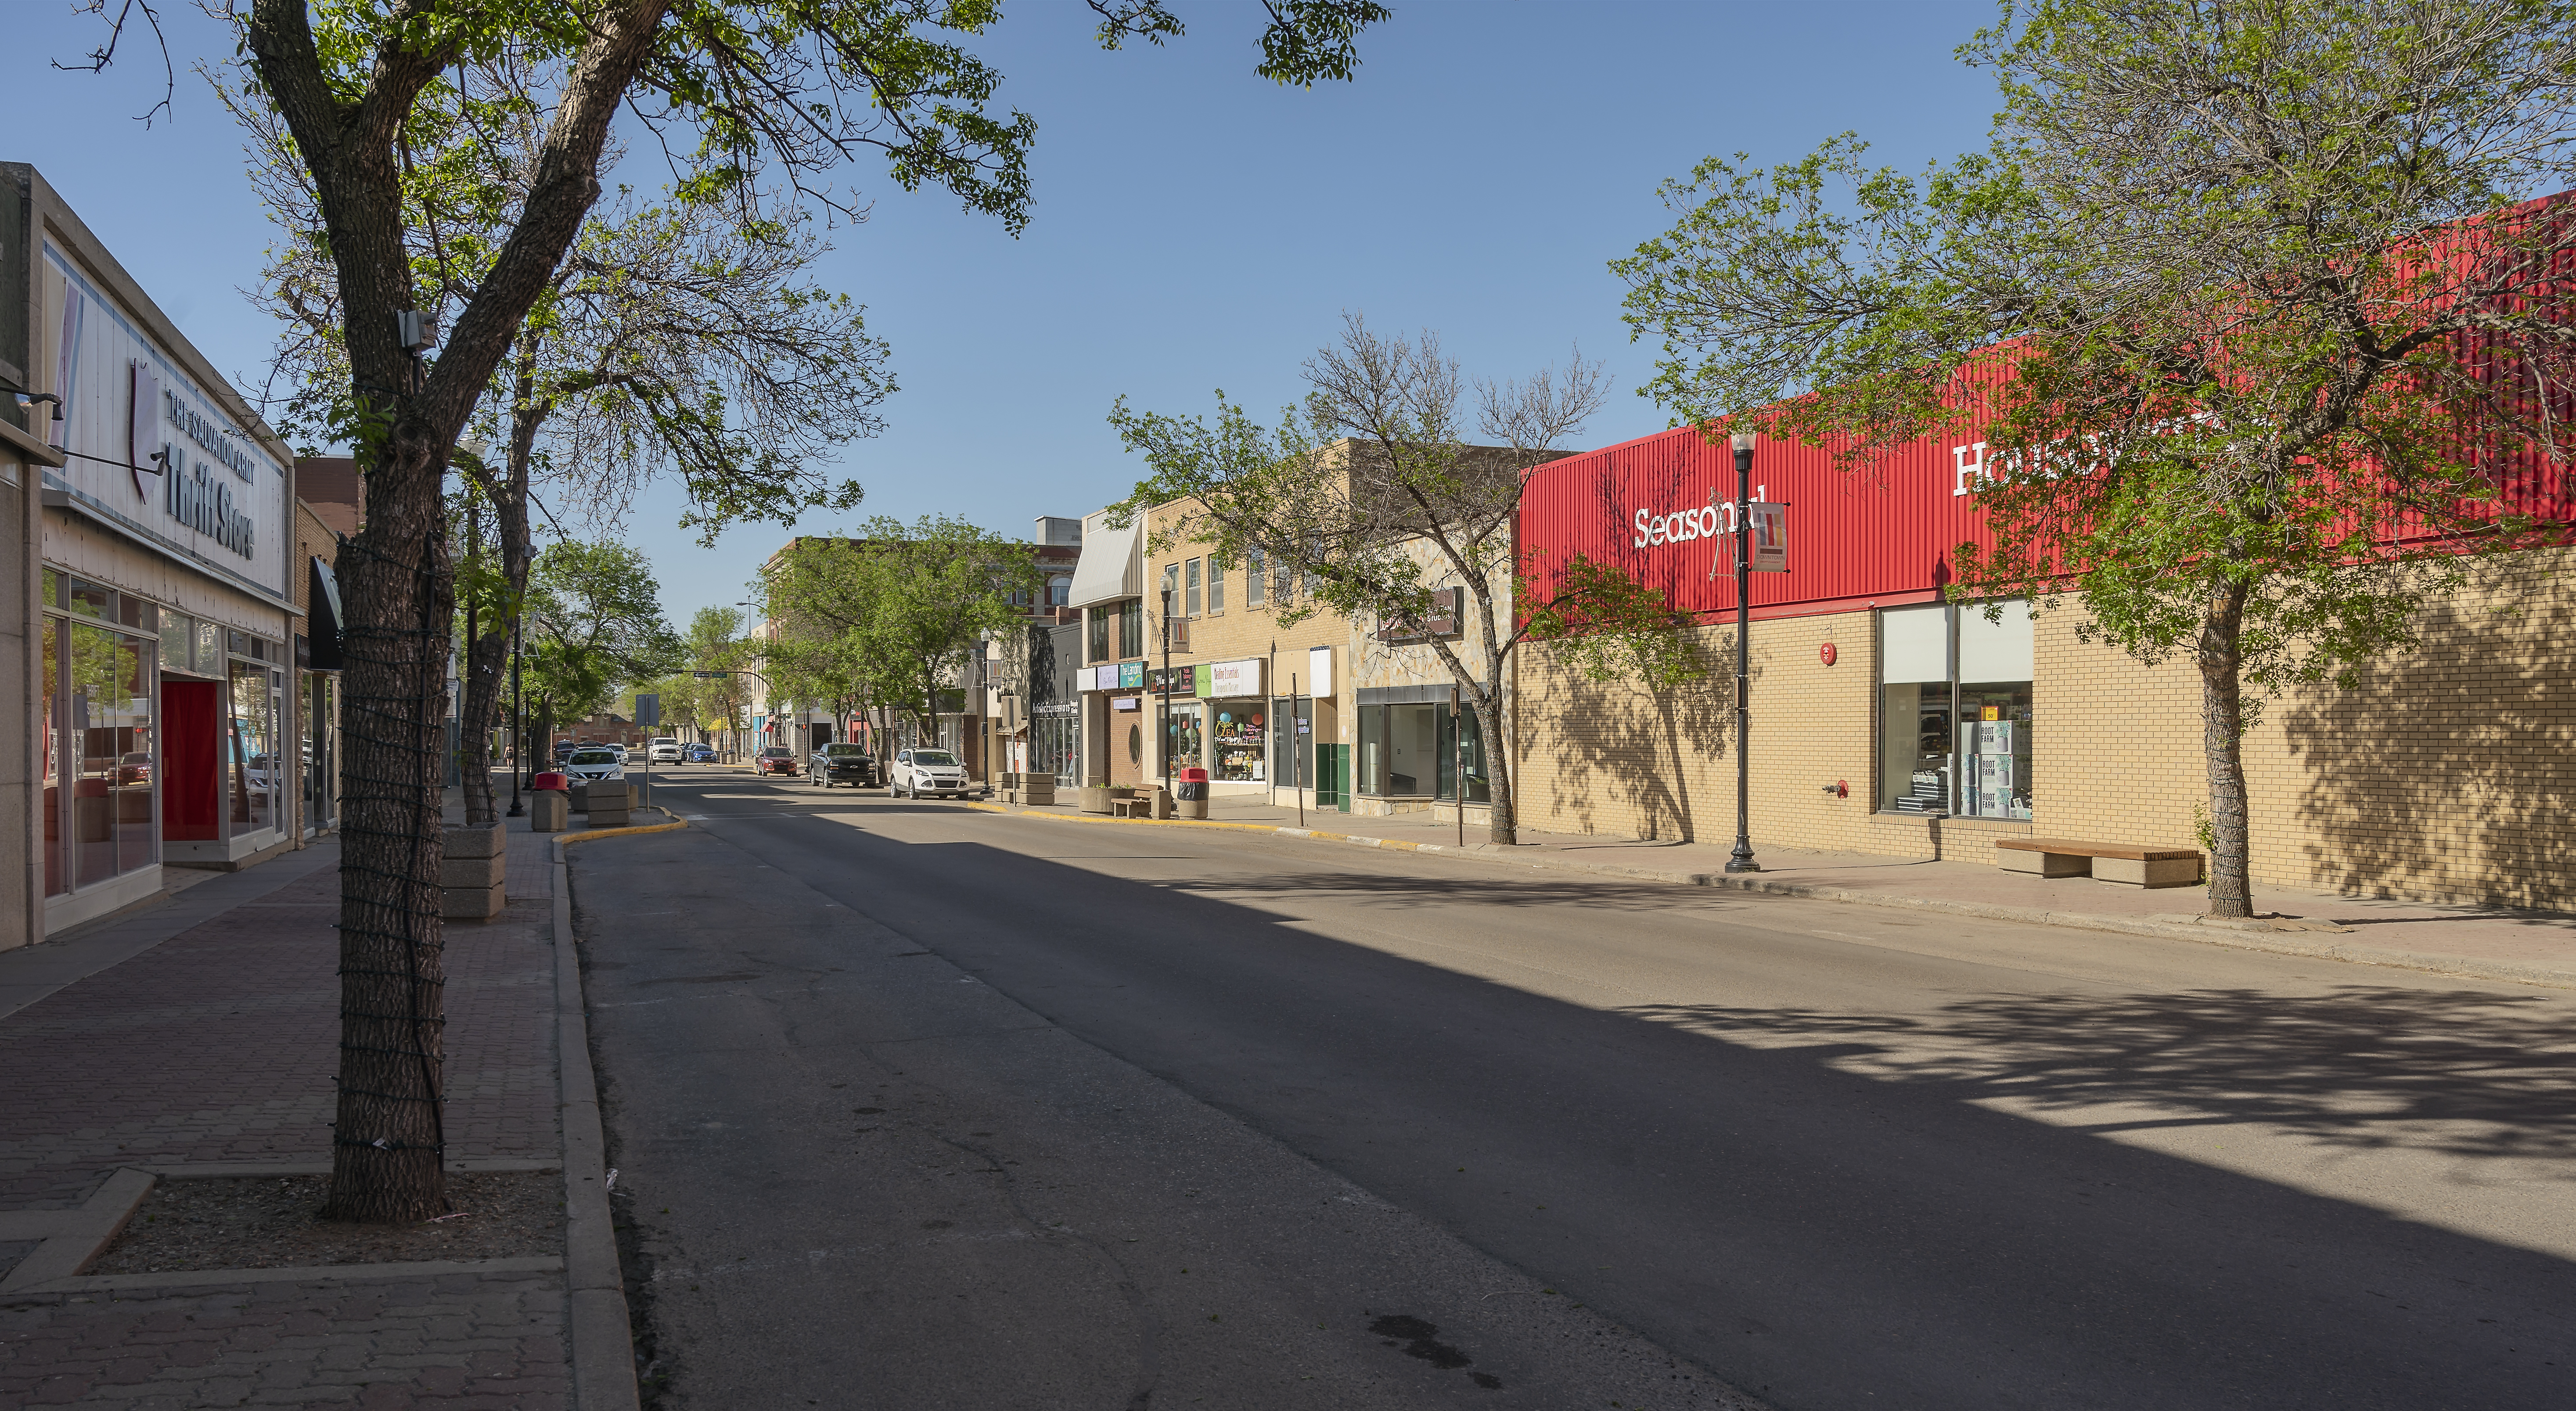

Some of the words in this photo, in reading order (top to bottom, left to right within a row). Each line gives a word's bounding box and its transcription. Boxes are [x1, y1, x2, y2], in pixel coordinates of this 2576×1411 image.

[169, 389, 188, 433] THE
[183, 410, 235, 470] SALVATION
[236, 450, 255, 487] ARMY
[168, 442, 216, 539] Thrift
[219, 481, 255, 561] Store
[1427, 614, 1451, 622] STUDS
[1127, 663, 1142, 676] Landing
[1214, 668, 1224, 681] Healing
[1225, 666, 1239, 679] Essentials
[86, 684, 99, 698] THRIFT
[1981, 727, 1994, 735] ROOT
[1982, 793, 1995, 801] ROOT
